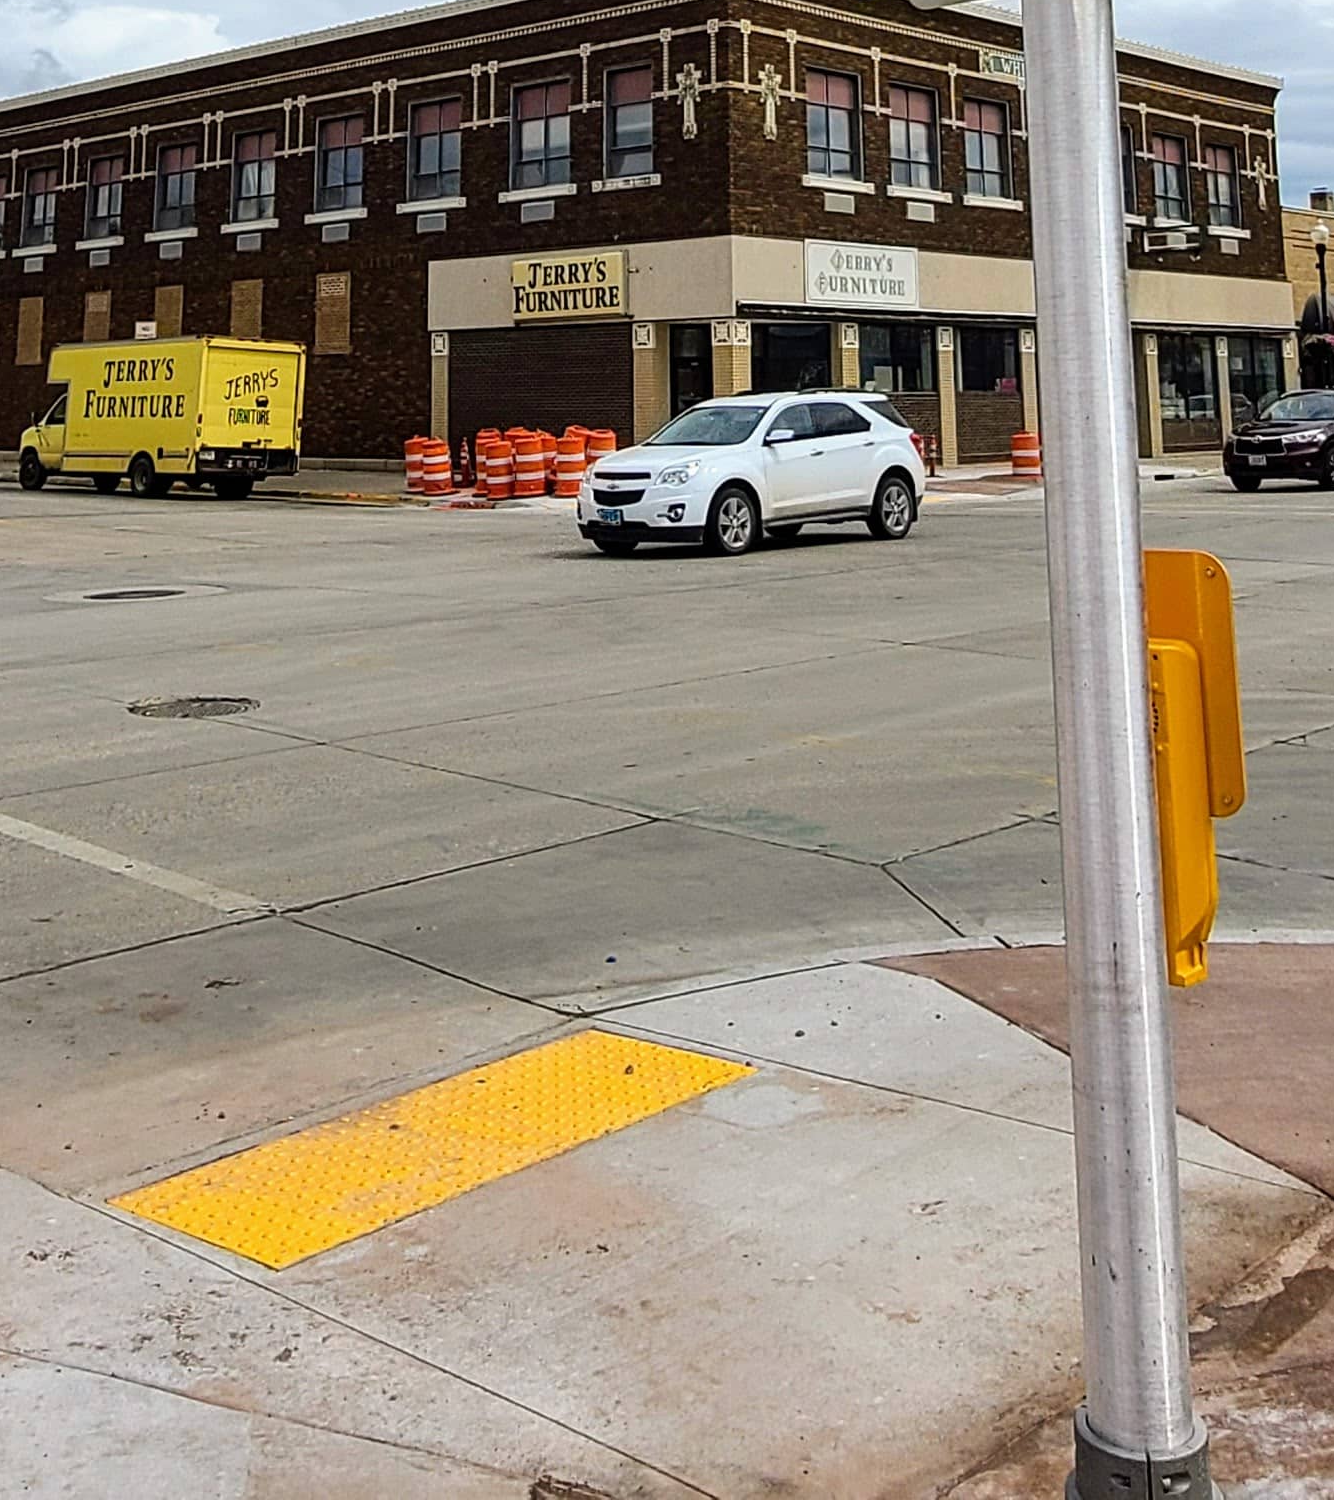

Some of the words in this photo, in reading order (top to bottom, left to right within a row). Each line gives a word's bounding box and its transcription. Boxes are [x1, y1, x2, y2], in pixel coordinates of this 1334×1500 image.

[528, 257, 607, 289] JERRY'S
[830, 249, 893, 273] JERRY'S
[513, 285, 620, 314] FURNITURE
[817, 273, 905, 296] FURNITURE
[103, 357, 174, 388] JERRY'S
[223, 368, 279, 401] JERRYS
[83, 389, 186, 419] FURNITURE
